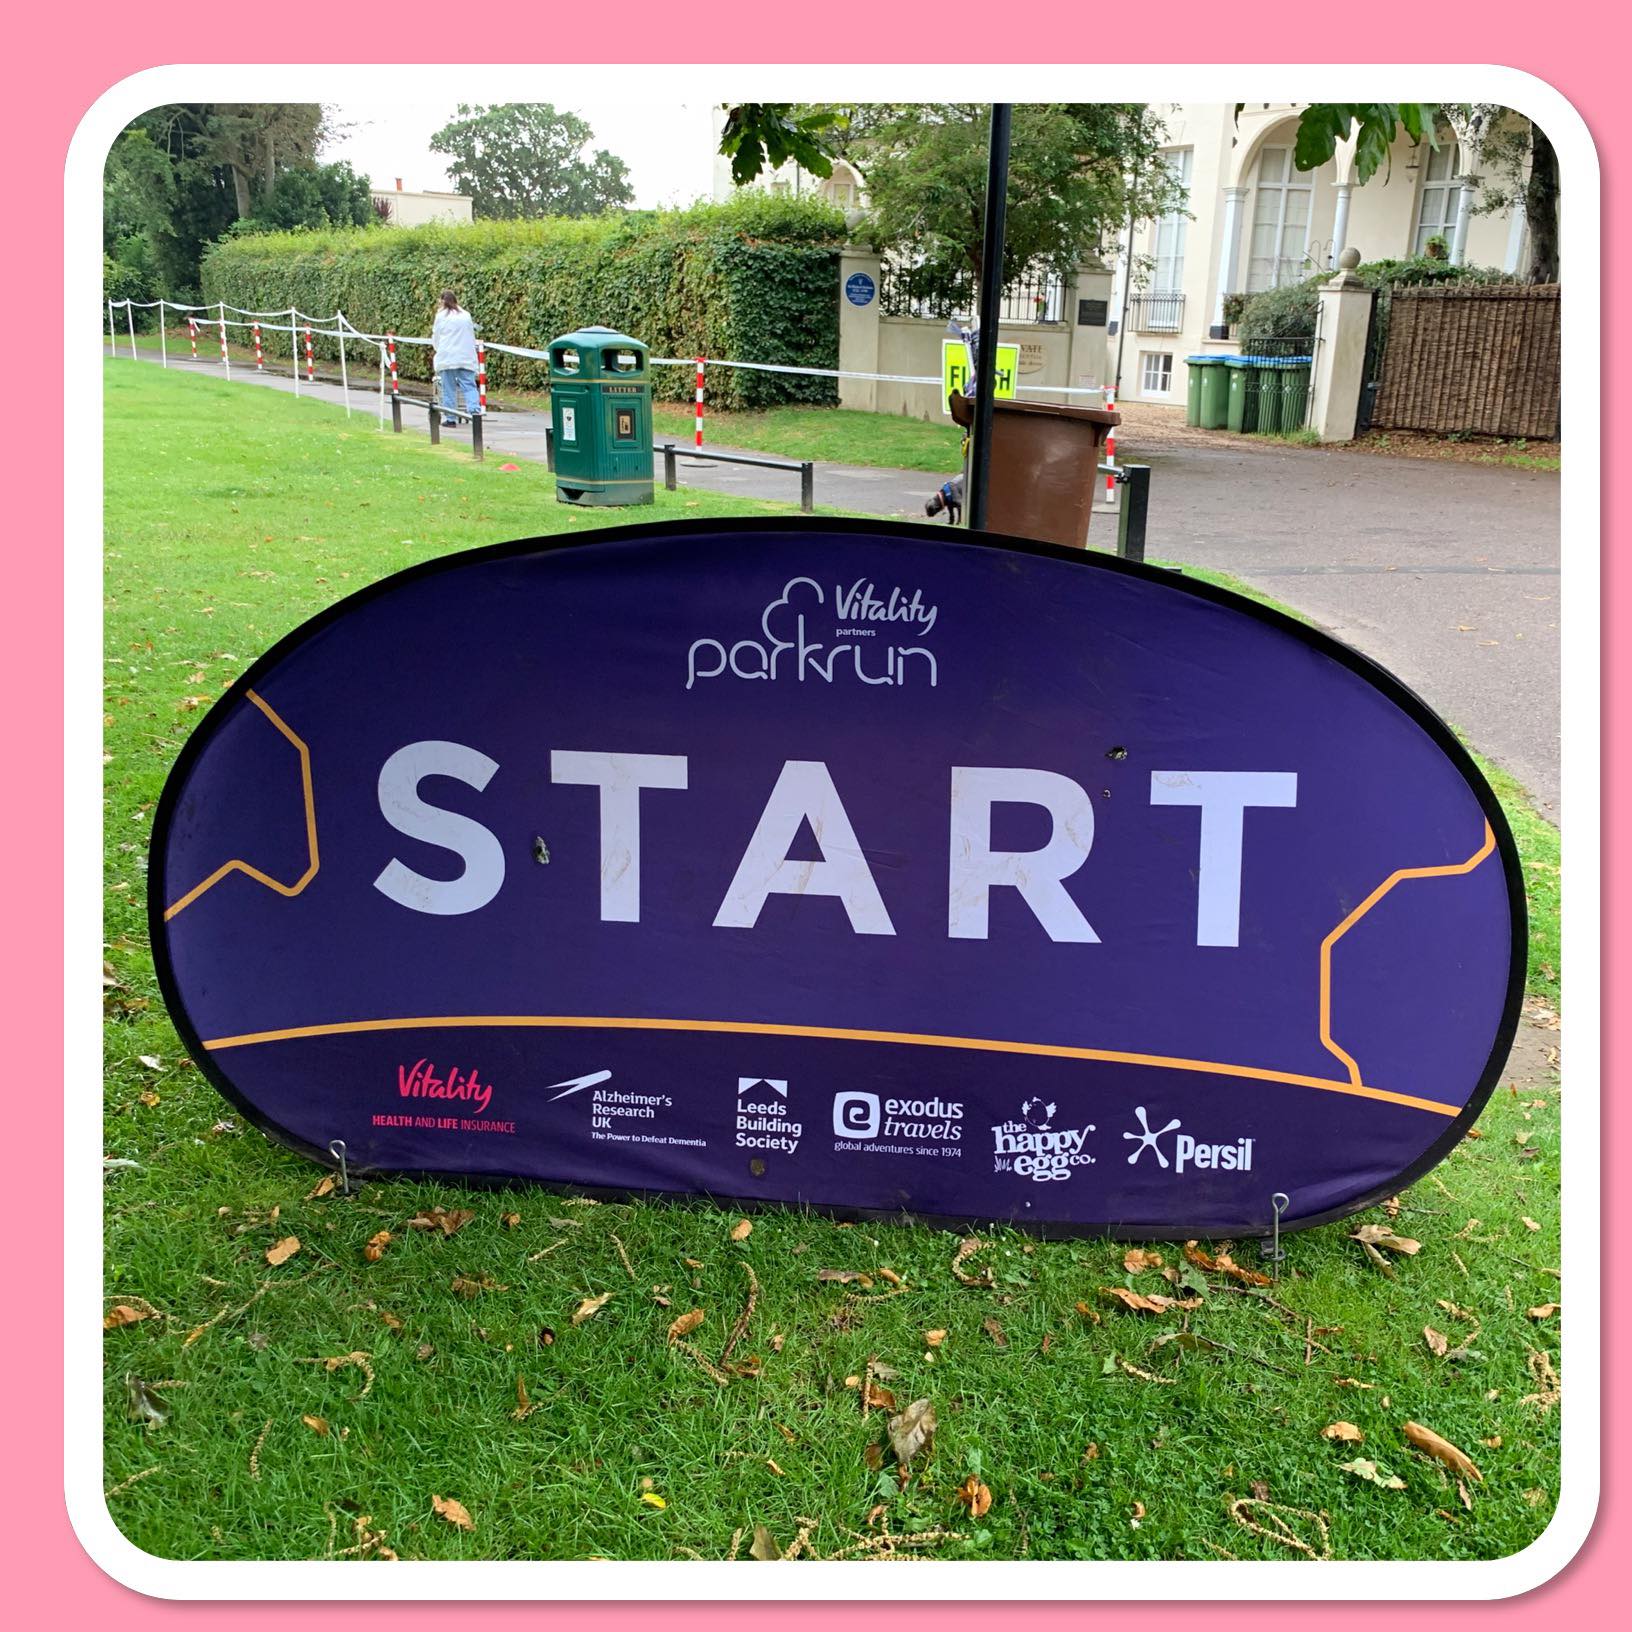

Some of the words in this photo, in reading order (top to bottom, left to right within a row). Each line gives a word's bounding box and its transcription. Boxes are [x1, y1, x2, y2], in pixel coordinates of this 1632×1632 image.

[950, 366, 1011, 390] FIH
[835, 577, 938, 637] Vitality
[835, 627, 876, 637] partners
[685, 612, 937, 689] parkrun
[372, 739, 1299, 948] START
[398, 1058, 493, 1114] Vitality
[593, 1090, 673, 1107] Alzheimer's
[737, 1099, 787, 1116] Leeds
[885, 1097, 964, 1119] exodus
[593, 1103, 655, 1119] Research
[372, 1115, 413, 1128] HEALTH
[415, 1117, 436, 1129] AND
[437, 1118, 458, 1131] LIFE
[461, 1120, 516, 1134] INSURANCE
[592, 1116, 612, 1129] UK
[736, 1116, 802, 1137] Building
[884, 1119, 962, 1141] travels
[1003, 1120, 1027, 1134] the
[592, 1131, 604, 1141] The
[605, 1132, 630, 1143] Power
[631, 1134, 640, 1143] to
[641, 1135, 667, 1145] Defeat
[668, 1137, 707, 1147] Dementia
[735, 1132, 799, 1154] Society
[834, 1141, 861, 1153] global
[863, 1143, 913, 1155] adventures
[915, 1146, 939, 1156] since
[941, 1147, 962, 1158] 1974
[991, 1124, 1096, 1156] happy
[1176, 1136, 1252, 1173] Persil
[1013, 1156, 1070, 1182] egg
